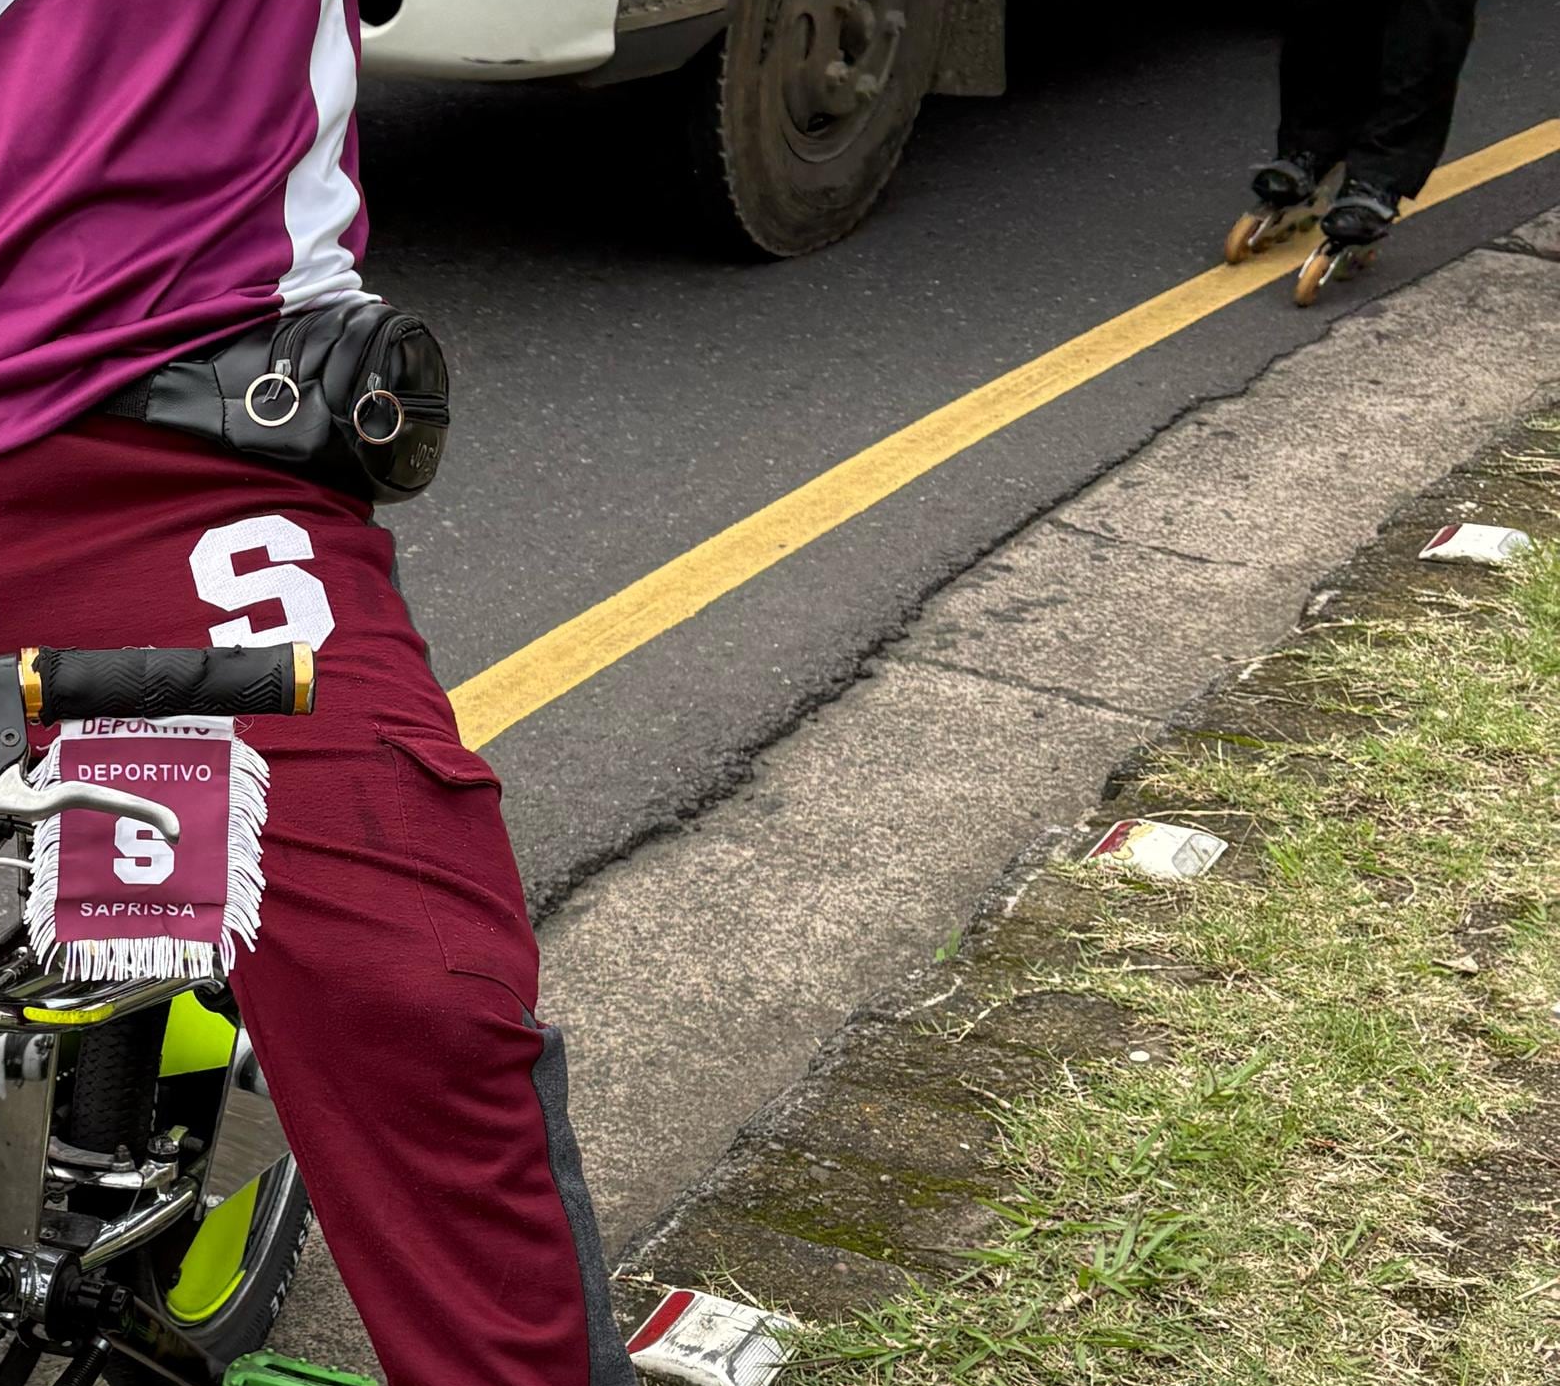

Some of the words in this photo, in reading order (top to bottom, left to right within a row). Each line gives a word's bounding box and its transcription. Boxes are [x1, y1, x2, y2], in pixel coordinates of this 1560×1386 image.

[189, 514, 336, 652] S
[78, 764, 212, 783] DEPORTIVO
[113, 816, 175, 885] S
[80, 902, 195, 919] SAPRISSA
